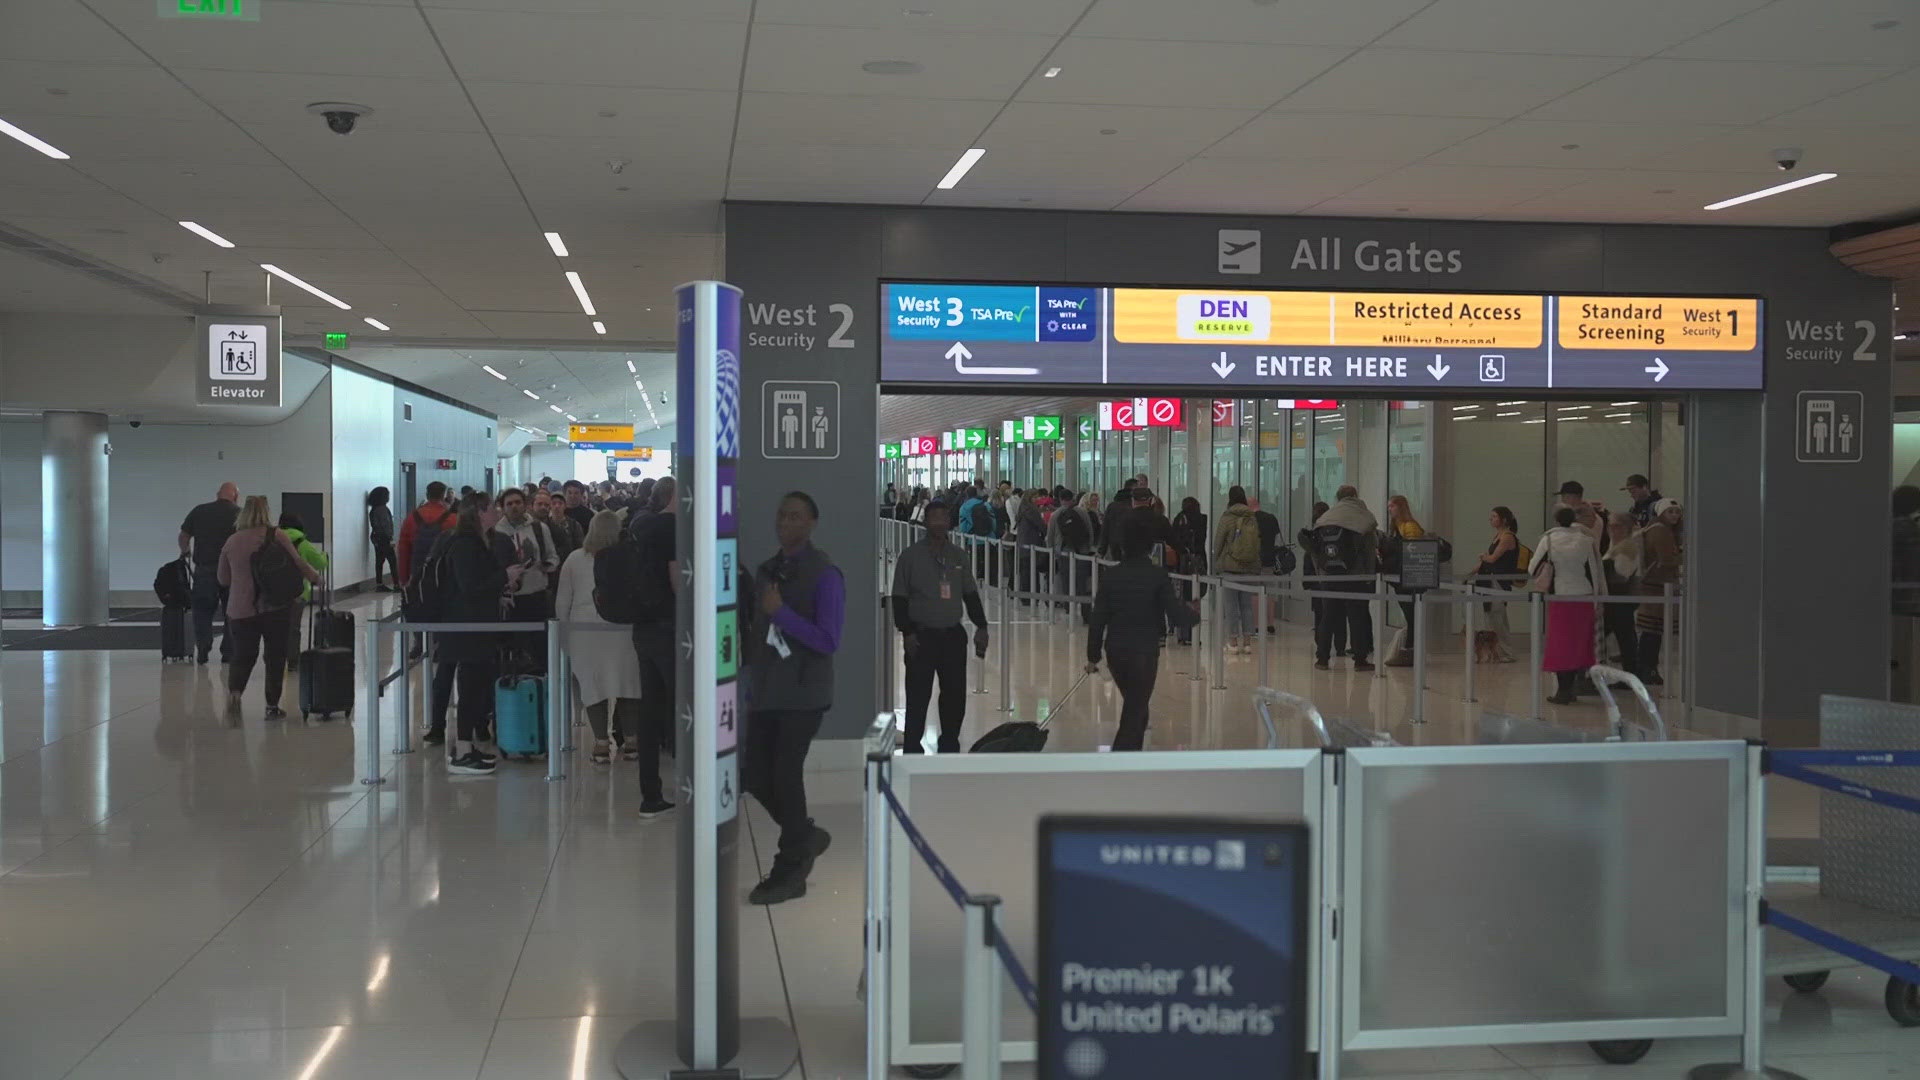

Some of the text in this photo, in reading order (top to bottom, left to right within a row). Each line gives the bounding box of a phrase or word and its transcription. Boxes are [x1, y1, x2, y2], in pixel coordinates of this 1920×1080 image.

[1291, 237, 1462, 273] All Gates
[898, 296, 940, 312] West
[947, 297, 963, 326] 3
[971, 308, 992, 320] TSA
[1048, 299, 1062, 308] TSA
[1200, 300, 1247, 318] DEN
[1355, 301, 1521, 320] Restricted Access
[1582, 303, 1662, 320] Standard
[748, 303, 855, 348] West 2
[897, 315, 940, 328] Security
[1198, 323, 1249, 332] RESERVE
[1684, 308, 1738, 336] West 1
[748, 332, 815, 351] Security
[1578, 324, 1664, 344] Screening
[1682, 326, 1721, 339] Security
[1786, 320, 1876, 360] West 2
[1786, 347, 1842, 364] Security
[1256, 356, 1407, 377] ENTER HERE
[211, 386, 265, 398] Elevator
[1100, 845, 1212, 865] UNITED
[1062, 963, 1234, 995] Premier 1K
[1062, 1001, 1275, 1036] United Polaris
